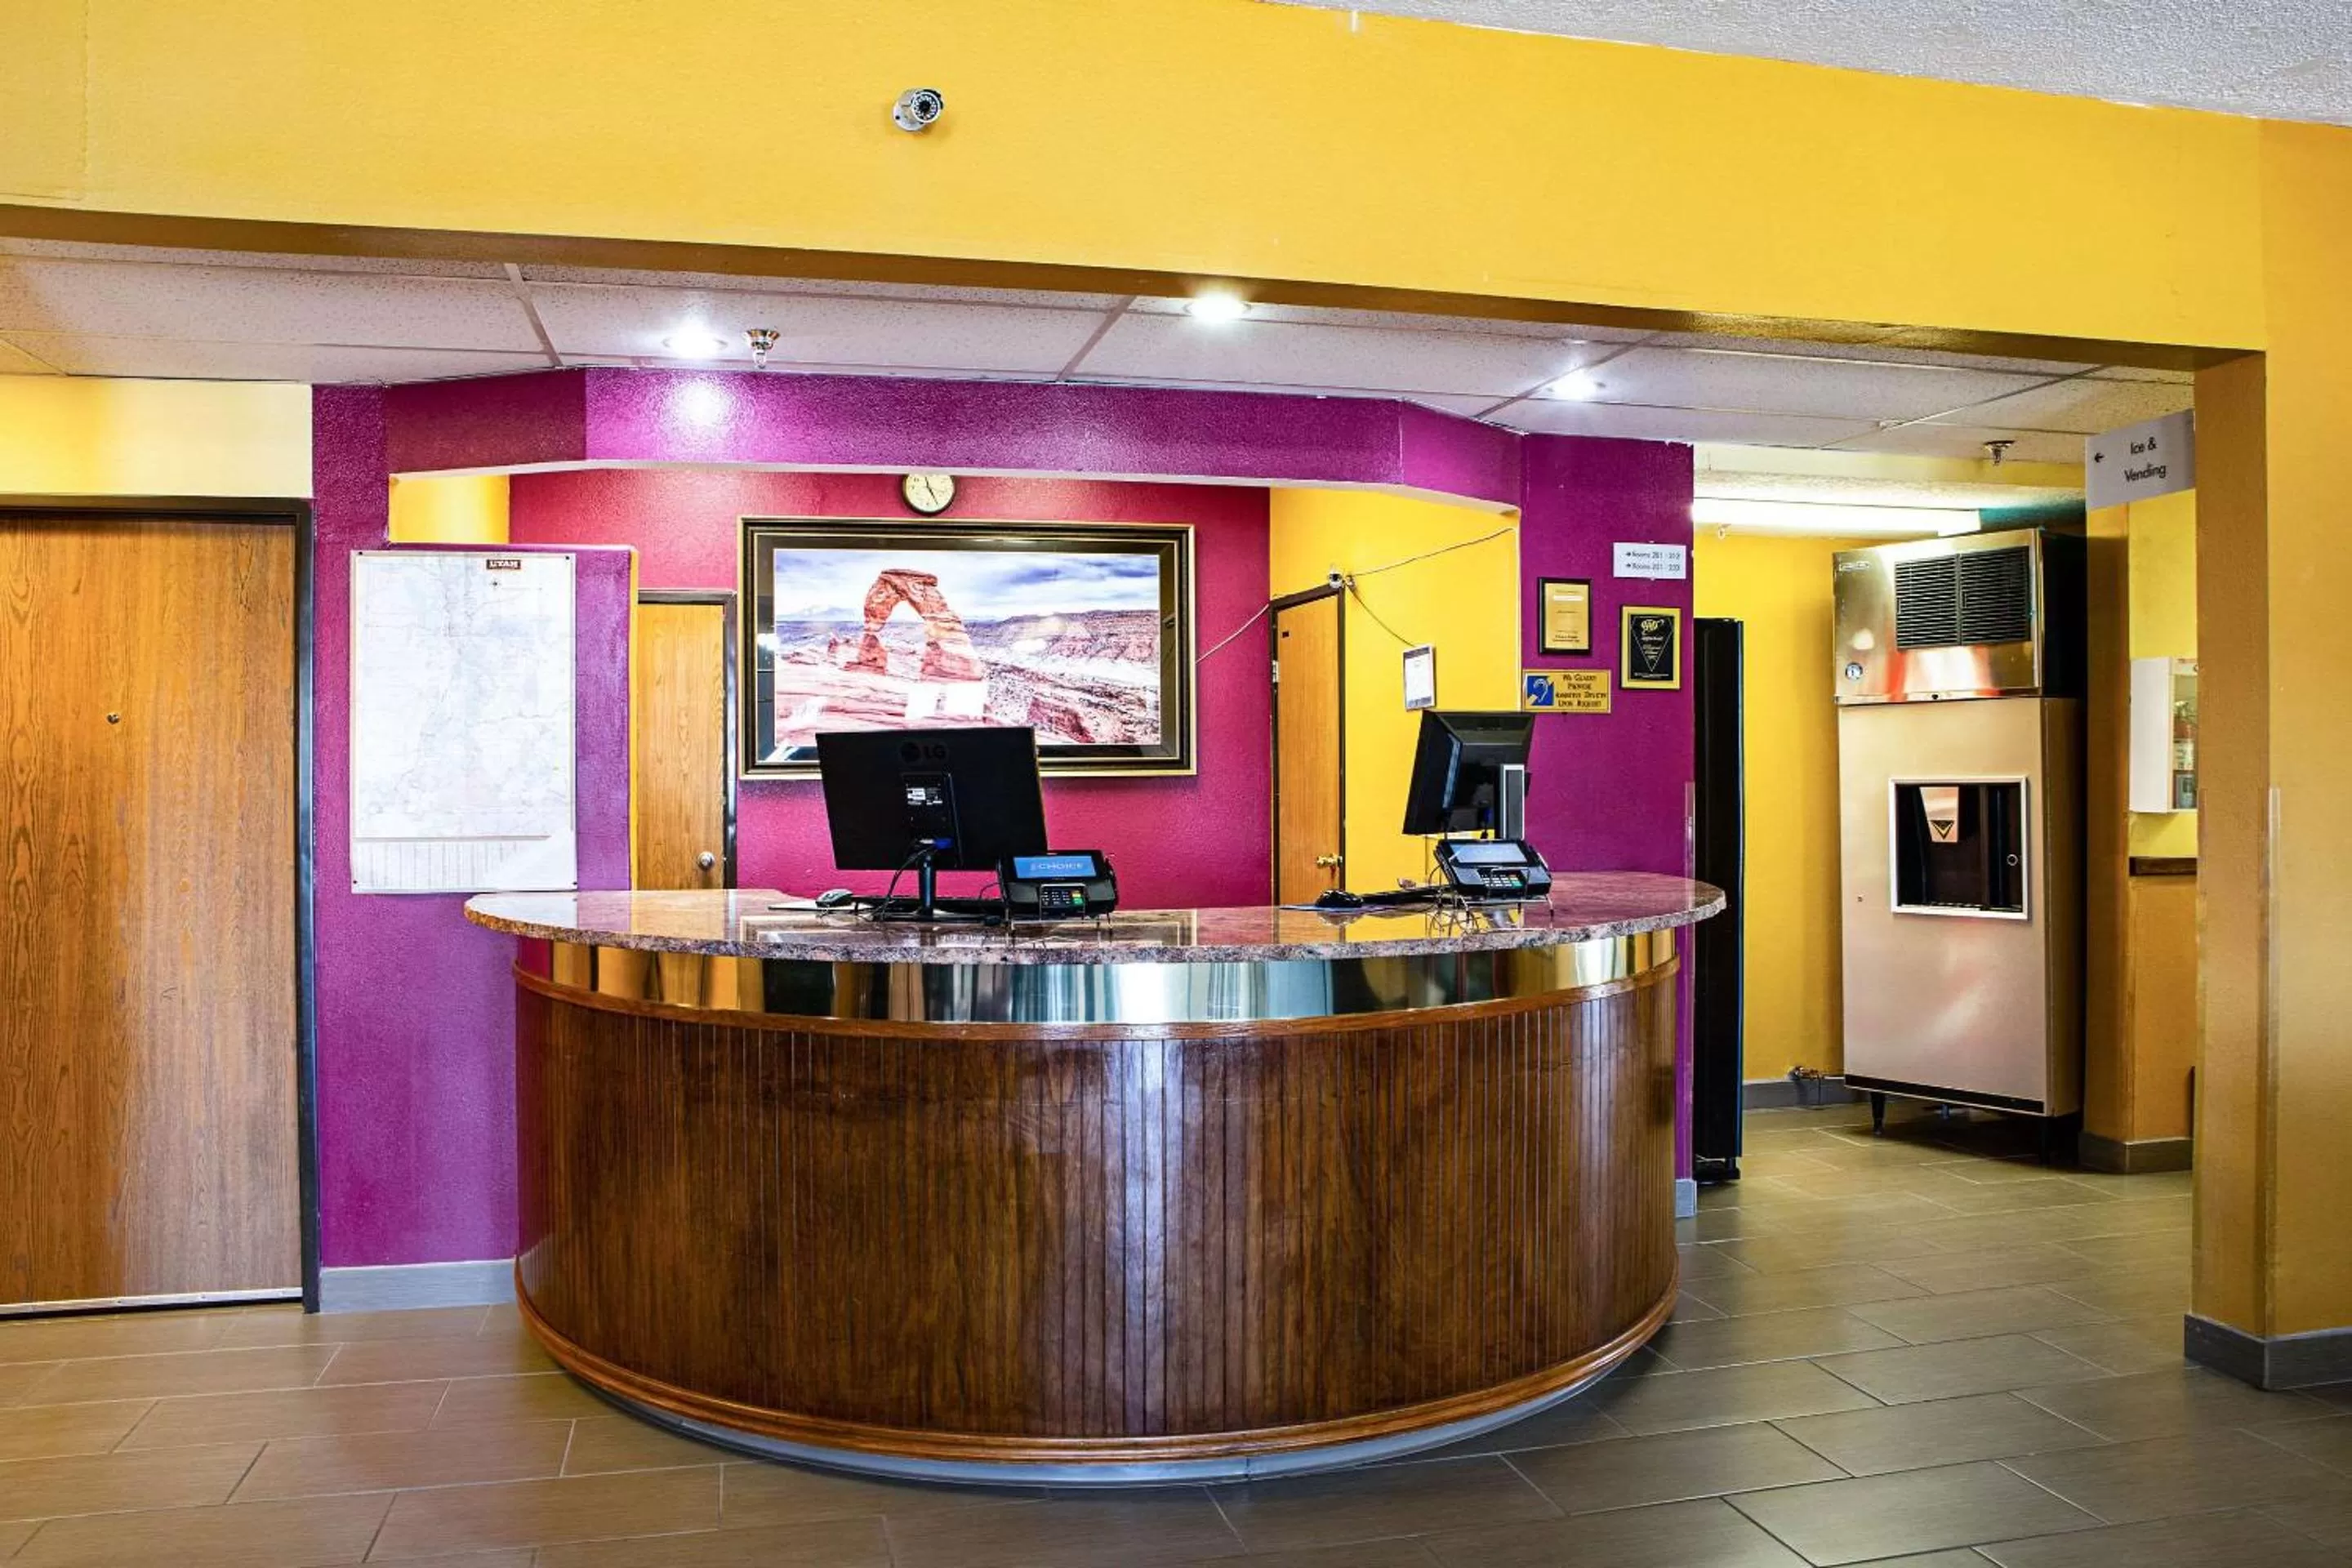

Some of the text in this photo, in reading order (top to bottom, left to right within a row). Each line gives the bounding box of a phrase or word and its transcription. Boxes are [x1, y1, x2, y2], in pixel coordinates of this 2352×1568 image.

[2130, 436, 2158, 455] Ice &
[2123, 463, 2167, 482] Vending
[490, 560, 518, 568] UTAH
[924, 744, 947, 760] LG
